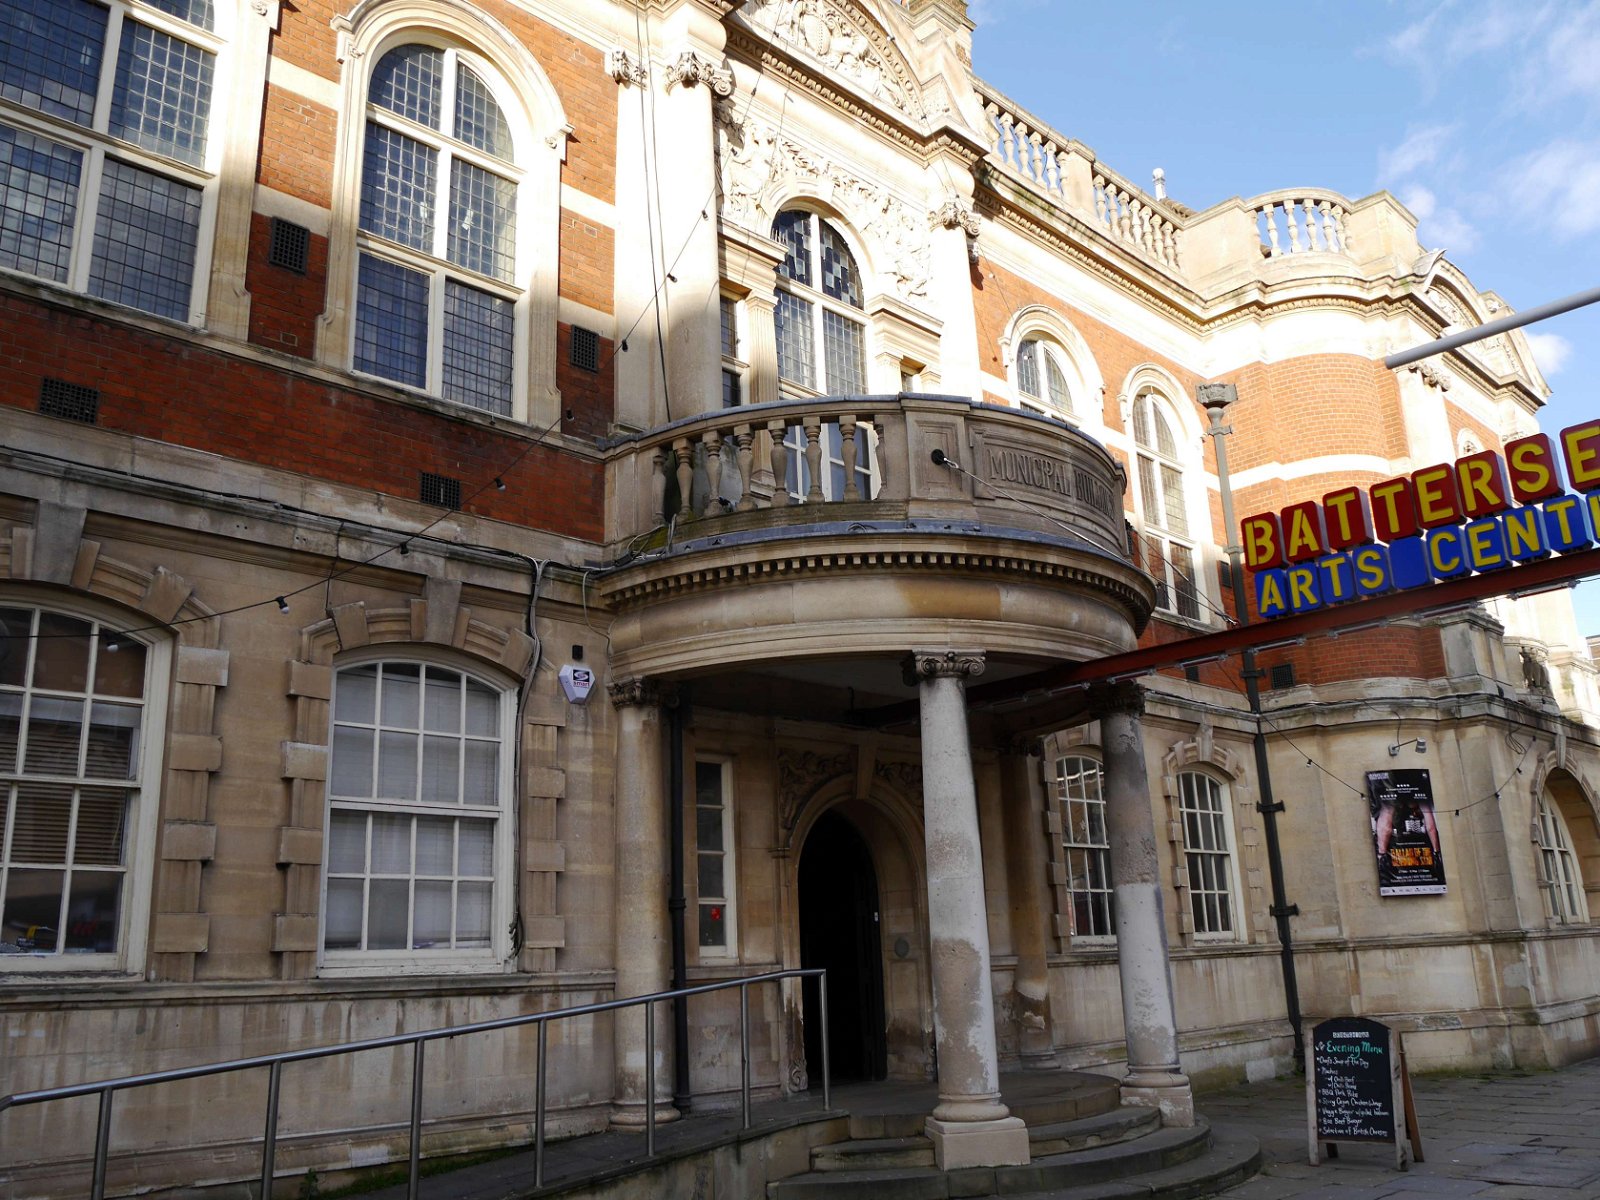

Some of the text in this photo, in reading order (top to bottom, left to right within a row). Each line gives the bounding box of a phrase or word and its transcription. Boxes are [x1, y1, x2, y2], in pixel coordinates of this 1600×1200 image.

[987, 448, 1073, 497] MUNICIPAL
[1260, 550, 1385, 614] ARTS
[1327, 1041, 1383, 1058] Evening Menu
